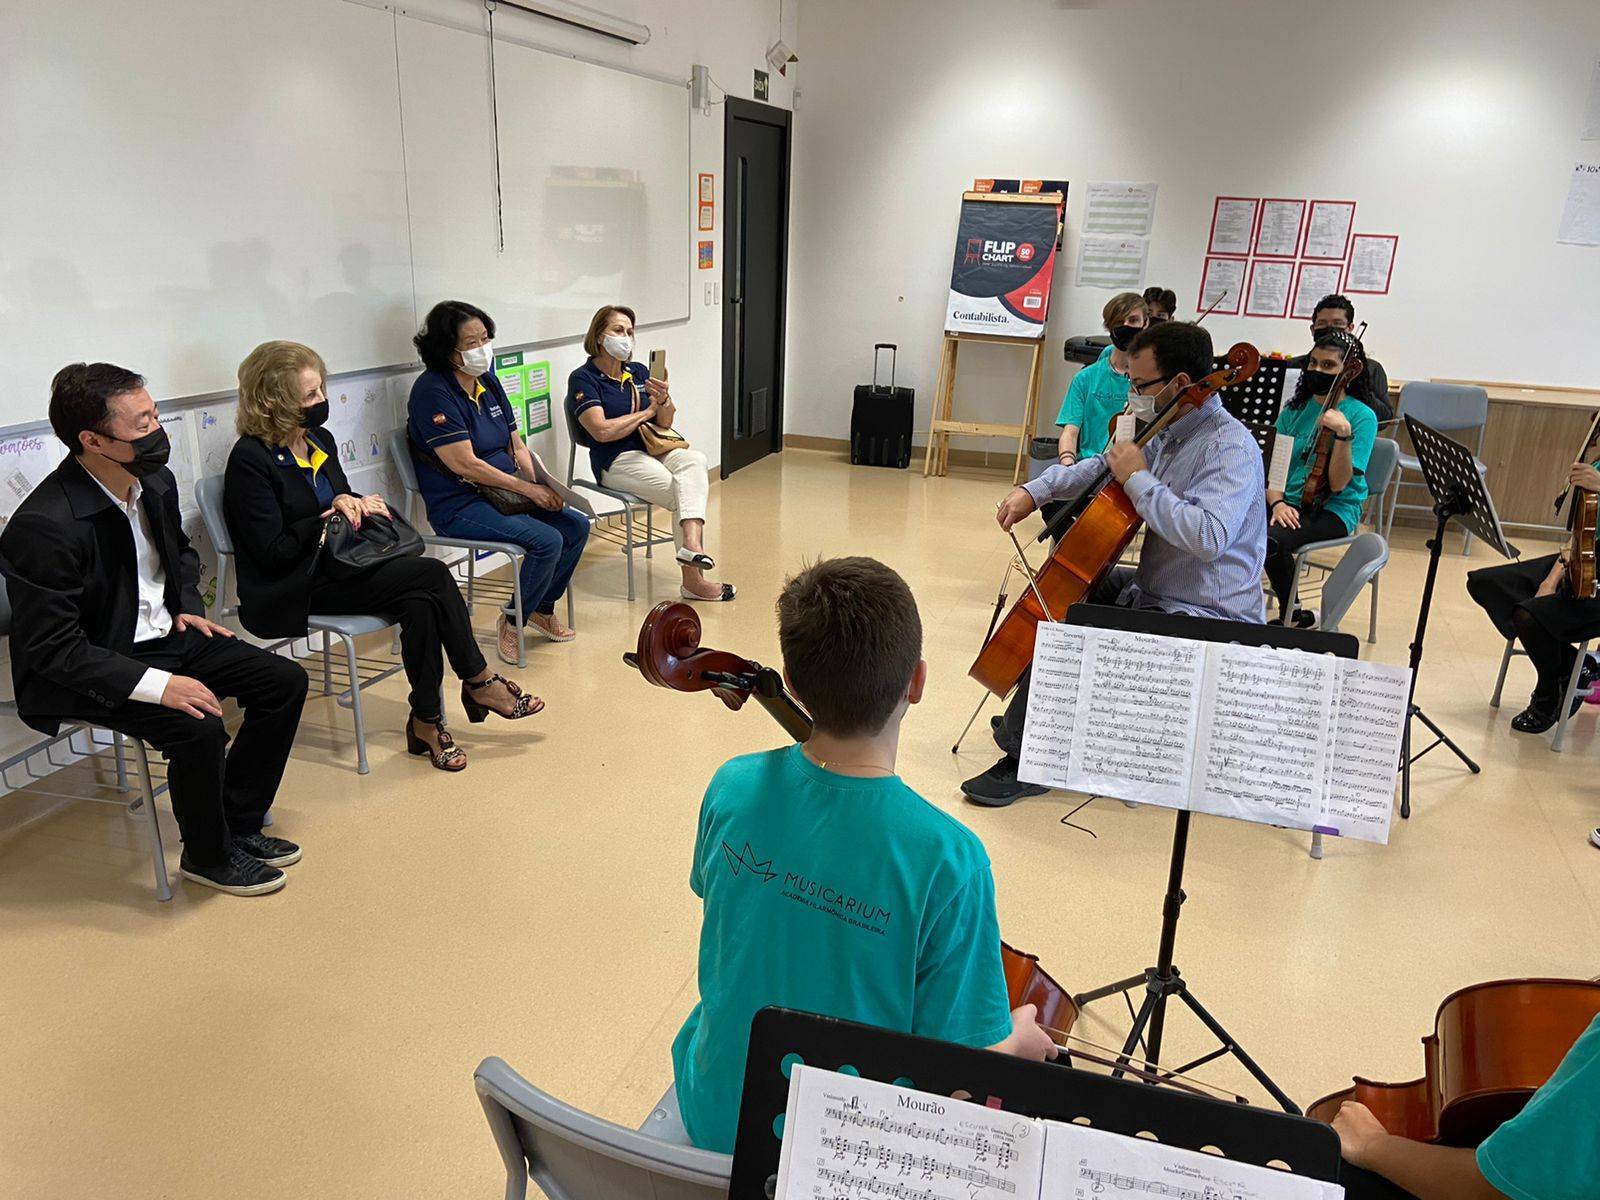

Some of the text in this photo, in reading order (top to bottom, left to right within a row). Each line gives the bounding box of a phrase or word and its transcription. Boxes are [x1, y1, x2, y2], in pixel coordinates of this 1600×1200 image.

[984, 241, 1016, 254] FLIP
[1021, 248, 1031, 256] 50
[982, 253, 1014, 262] CHART
[953, 310, 1010, 324] Contabilista.
[783, 872, 891, 925] MUSICARIUM
[897, 1094, 946, 1116] Mourão
